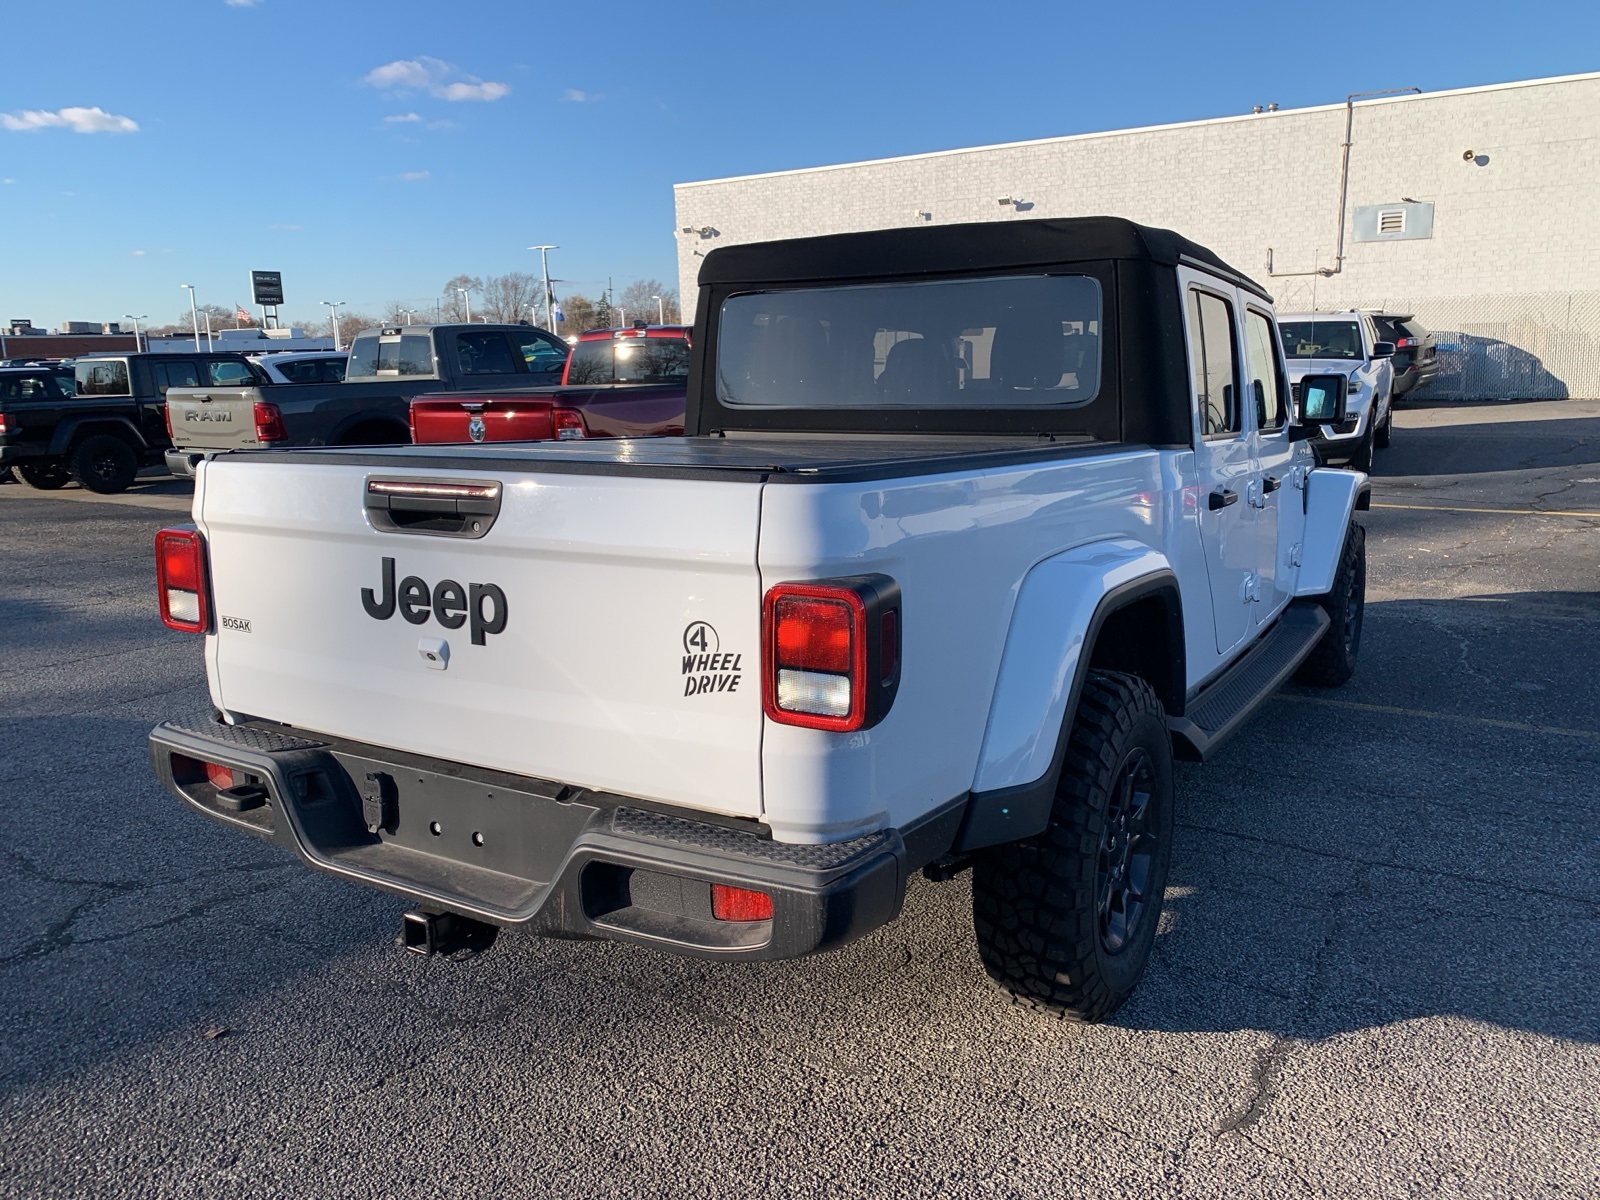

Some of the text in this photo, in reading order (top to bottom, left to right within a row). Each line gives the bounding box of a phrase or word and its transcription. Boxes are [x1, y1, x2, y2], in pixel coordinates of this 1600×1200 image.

[185, 410, 232, 422] RAM
[361, 556, 508, 646] Jeep
[222, 617, 251, 631] BOSAK
[689, 626, 708, 652] 4
[682, 653, 742, 675] WHEEL
[684, 674, 742, 697] DRIVE
